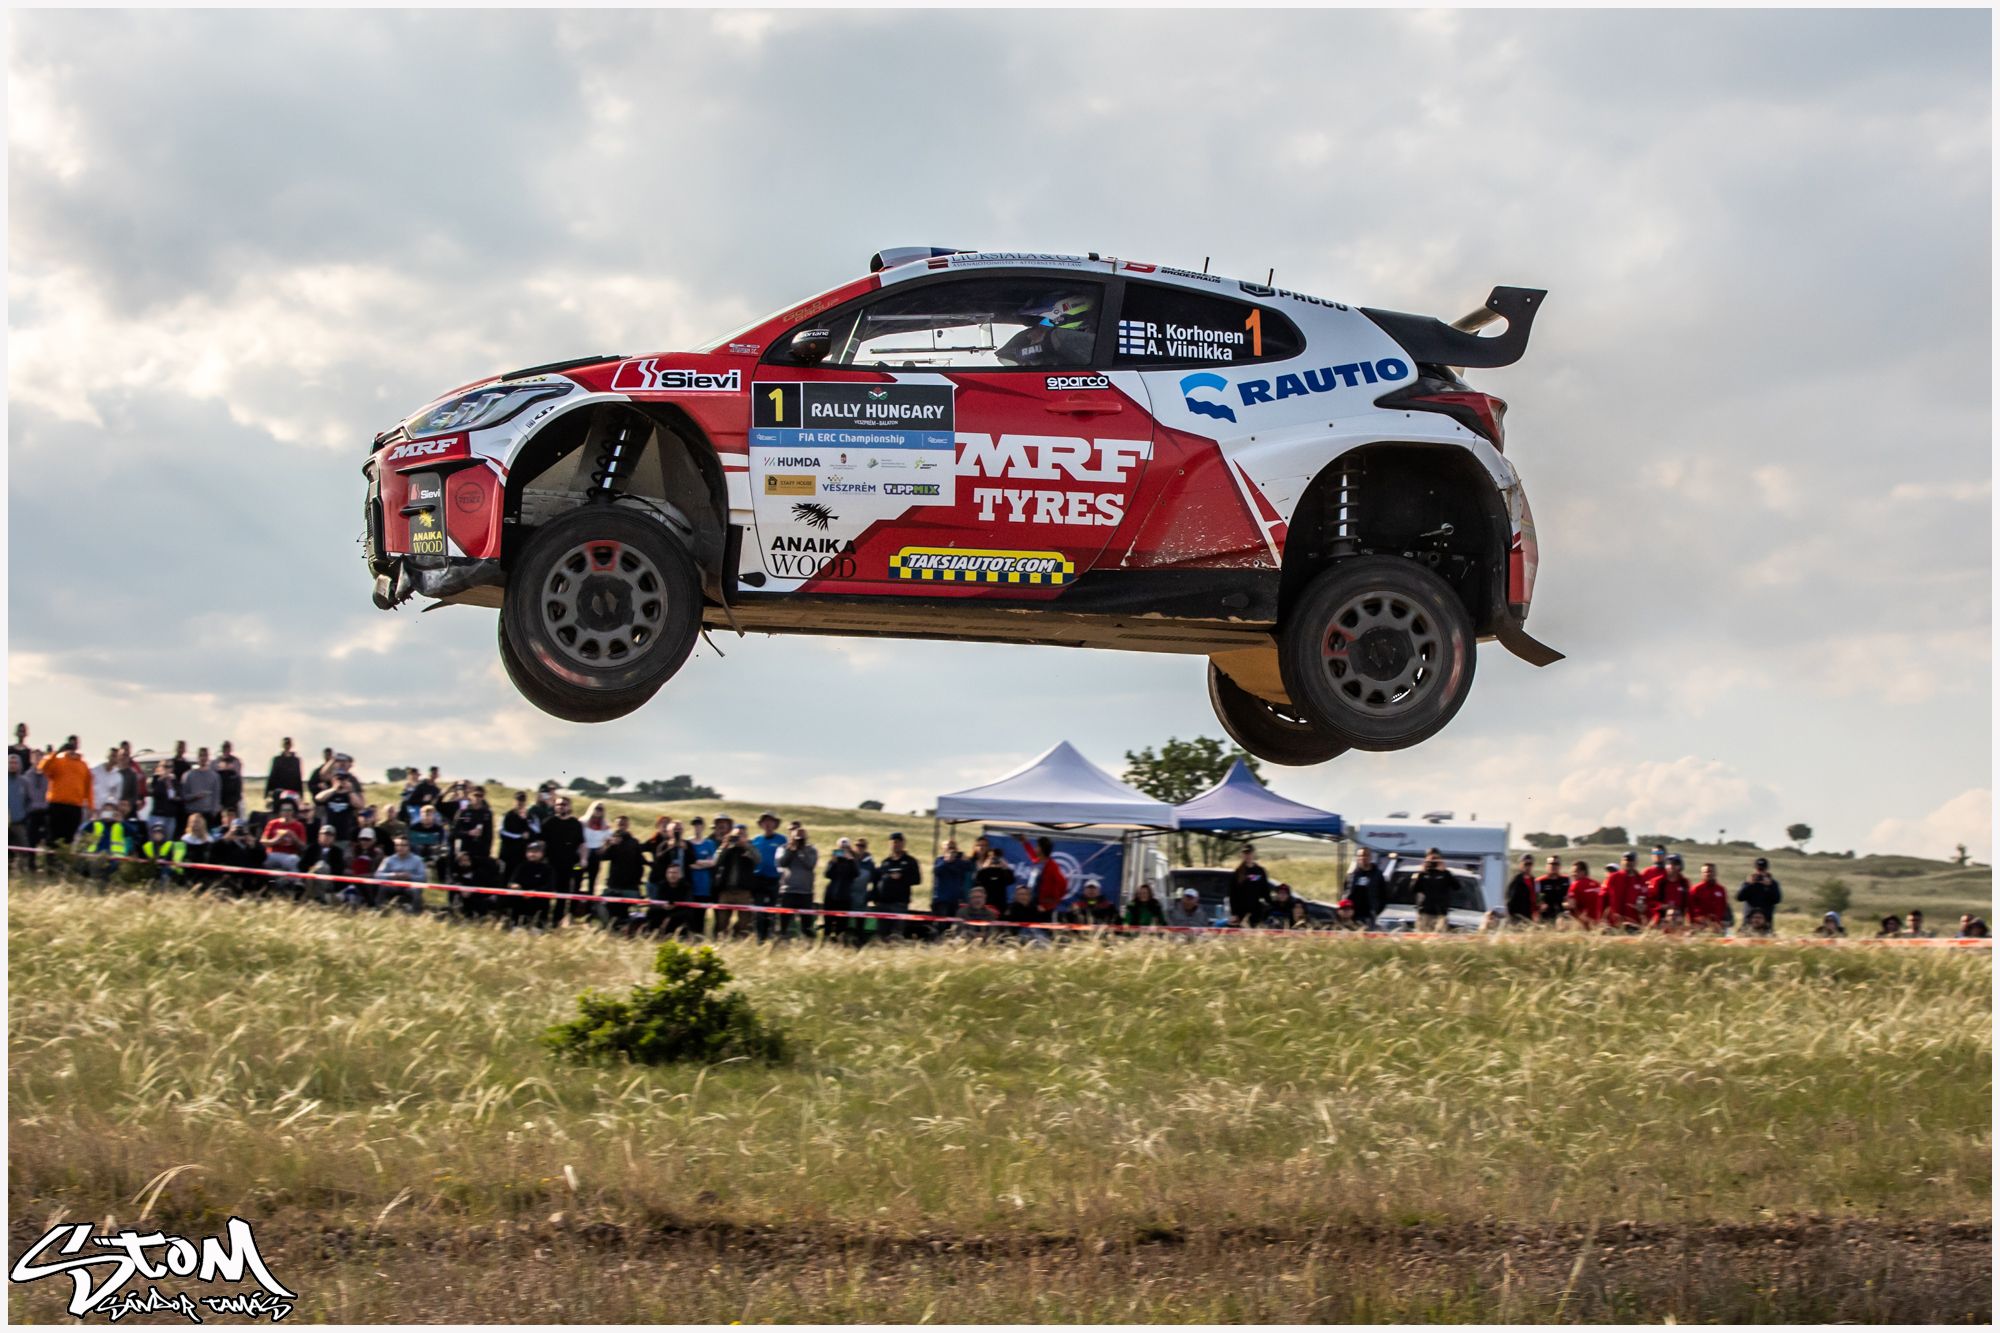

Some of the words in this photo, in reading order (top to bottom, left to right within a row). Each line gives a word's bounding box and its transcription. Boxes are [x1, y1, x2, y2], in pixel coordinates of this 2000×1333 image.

[1146, 322, 1162, 339] R.
[1166, 323, 1244, 345] Korhonen
[1245, 308, 1263, 357] 1
[1146, 340, 1163, 356] A.
[1166, 341, 1233, 361] Viinikka
[661, 371, 738, 389] Sievi
[1047, 376, 1109, 389] sparco
[1237, 357, 1409, 407] RAUTIO
[767, 387, 784, 422] 1
[811, 403, 861, 419] RALLY
[866, 404, 945, 420] HUNGARY
[798, 432, 815, 443] FIA
[817, 432, 836, 443] ERC
[839, 432, 905, 445] Championship
[387, 437, 459, 461] MRF
[953, 432, 1155, 484] MRF
[777, 457, 821, 467] HUMDA
[420, 488, 441, 500] Sievi
[822, 481, 876, 493] VESZPRÉM
[973, 487, 1125, 527] TYRES
[413, 531, 443, 542] ANAIKA
[771, 536, 857, 555] ANAIKA
[413, 541, 443, 553] WOOD
[771, 553, 857, 579] WOOD
[908, 553, 1057, 574] TAKSIAUTOT.COM
